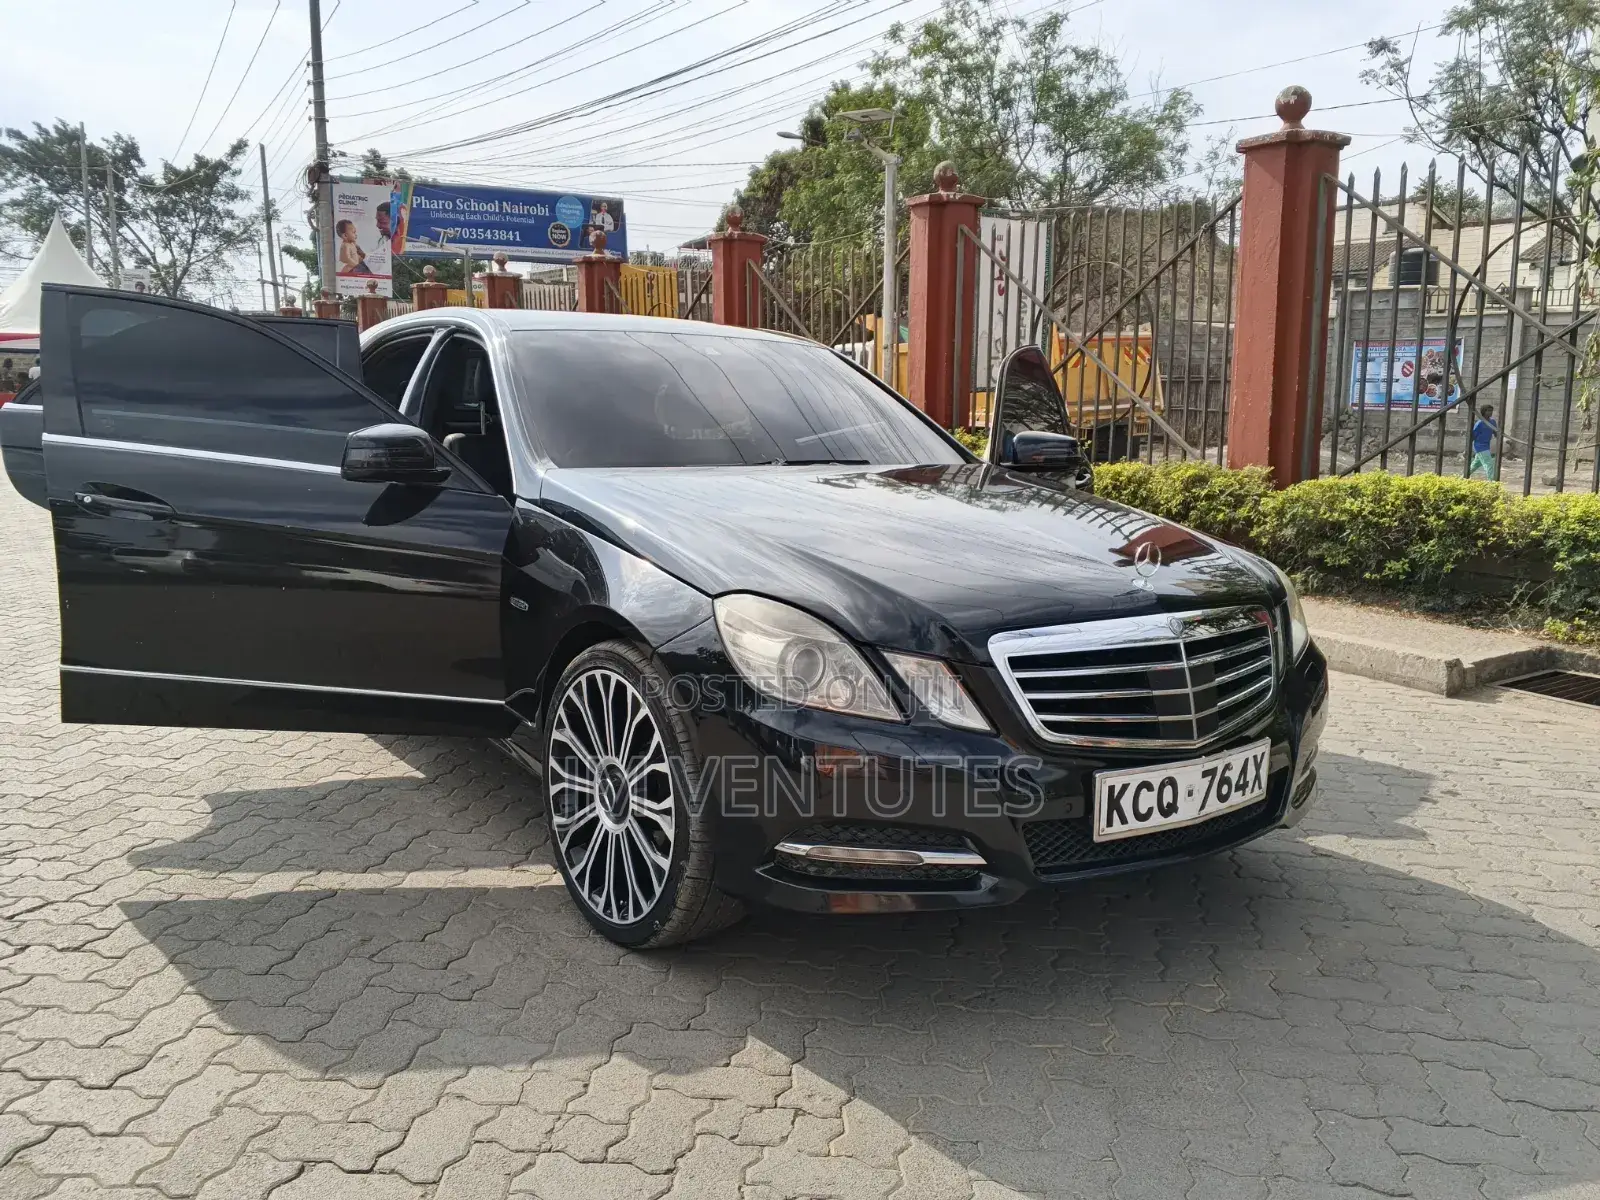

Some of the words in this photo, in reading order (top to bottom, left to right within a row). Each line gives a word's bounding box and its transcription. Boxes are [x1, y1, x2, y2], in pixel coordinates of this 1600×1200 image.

[412, 195, 453, 210] Pharo
[456, 198, 500, 213] School
[502, 201, 550, 217] Nairobi
[430, 211, 465, 221] Unlocking
[483, 213, 505, 222] Child's
[506, 216, 535, 224] Potential
[1105, 775, 1180, 829] KCQ
[1198, 750, 1267, 817] 764X
